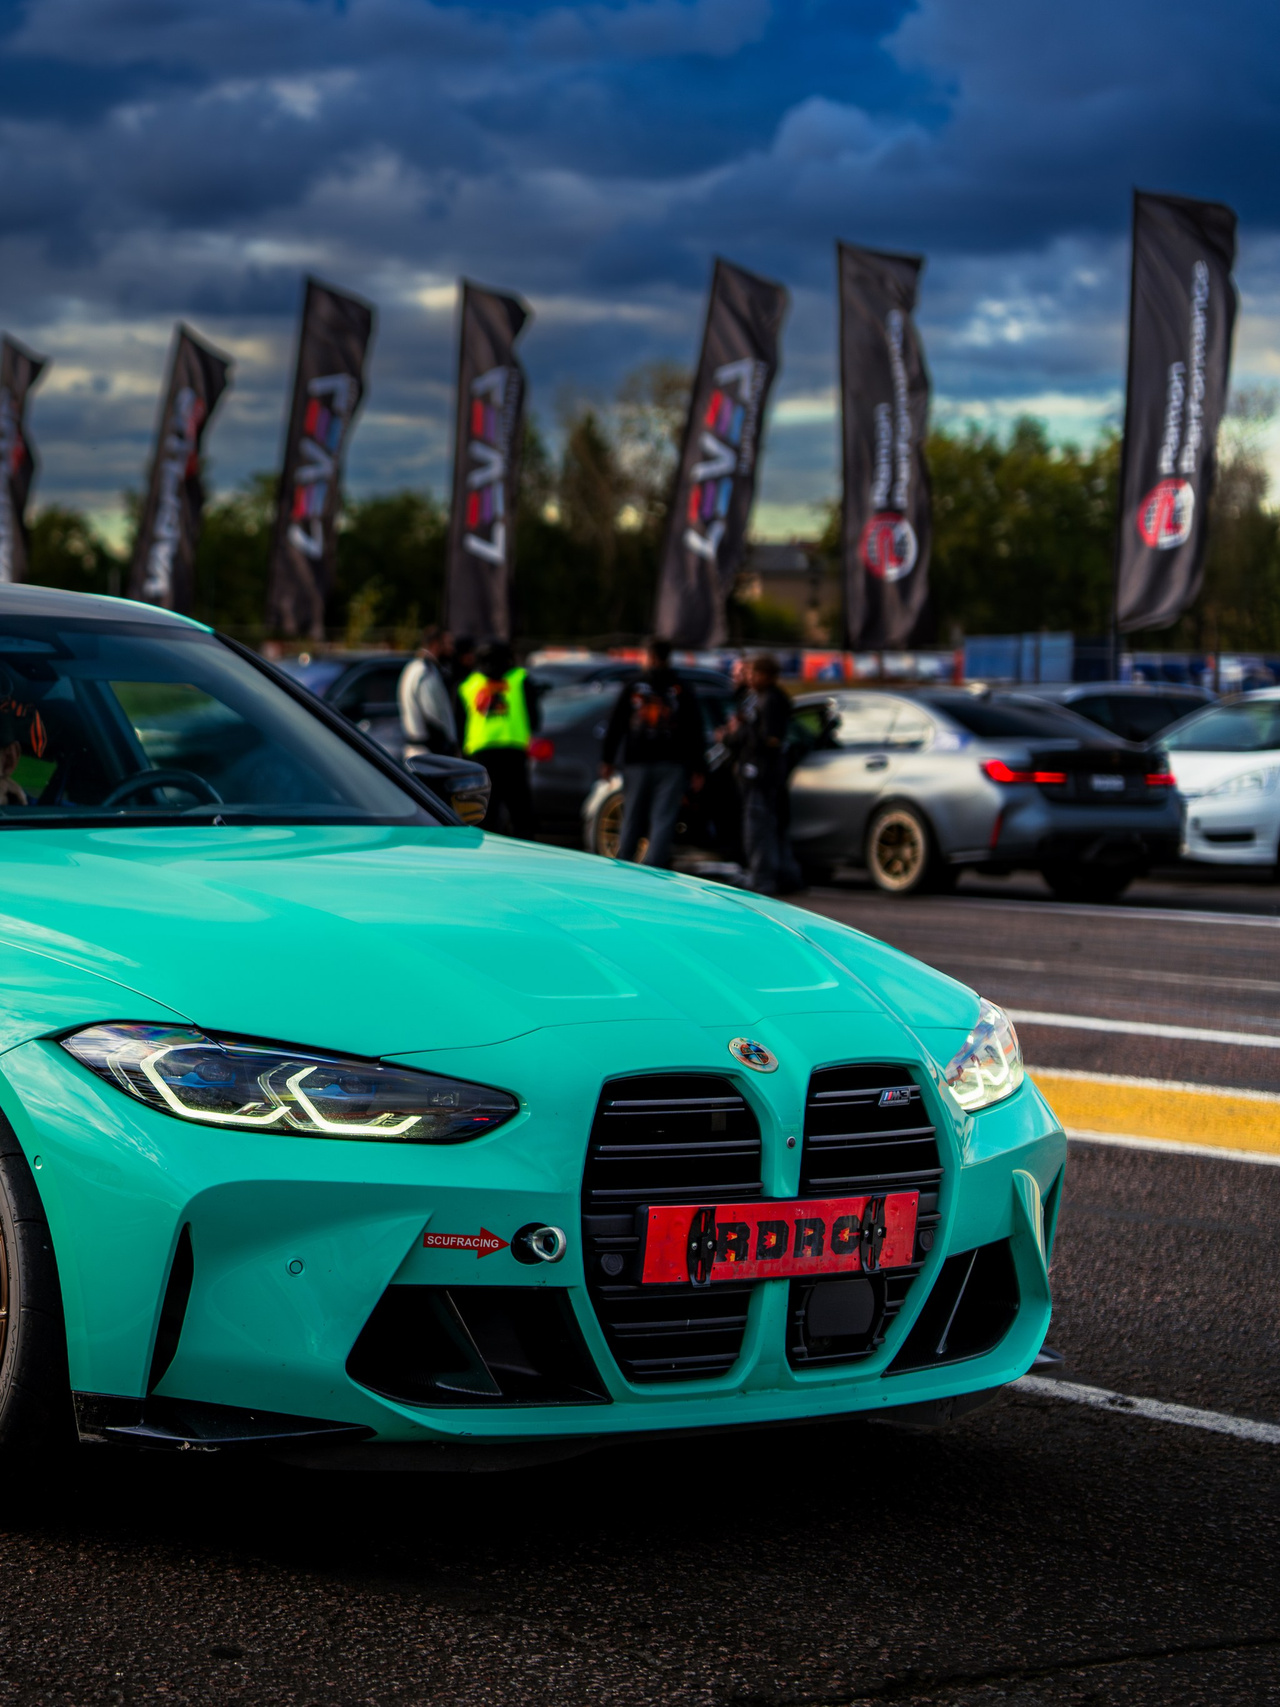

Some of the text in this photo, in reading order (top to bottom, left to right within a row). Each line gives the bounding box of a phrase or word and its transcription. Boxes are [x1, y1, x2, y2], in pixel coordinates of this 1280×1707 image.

[1178, 259, 1210, 474] Performance
[1157, 361, 1187, 475] Ramon
[426, 1235, 500, 1249] SCUFRACING
[716, 1214, 862, 1263] RDRC
